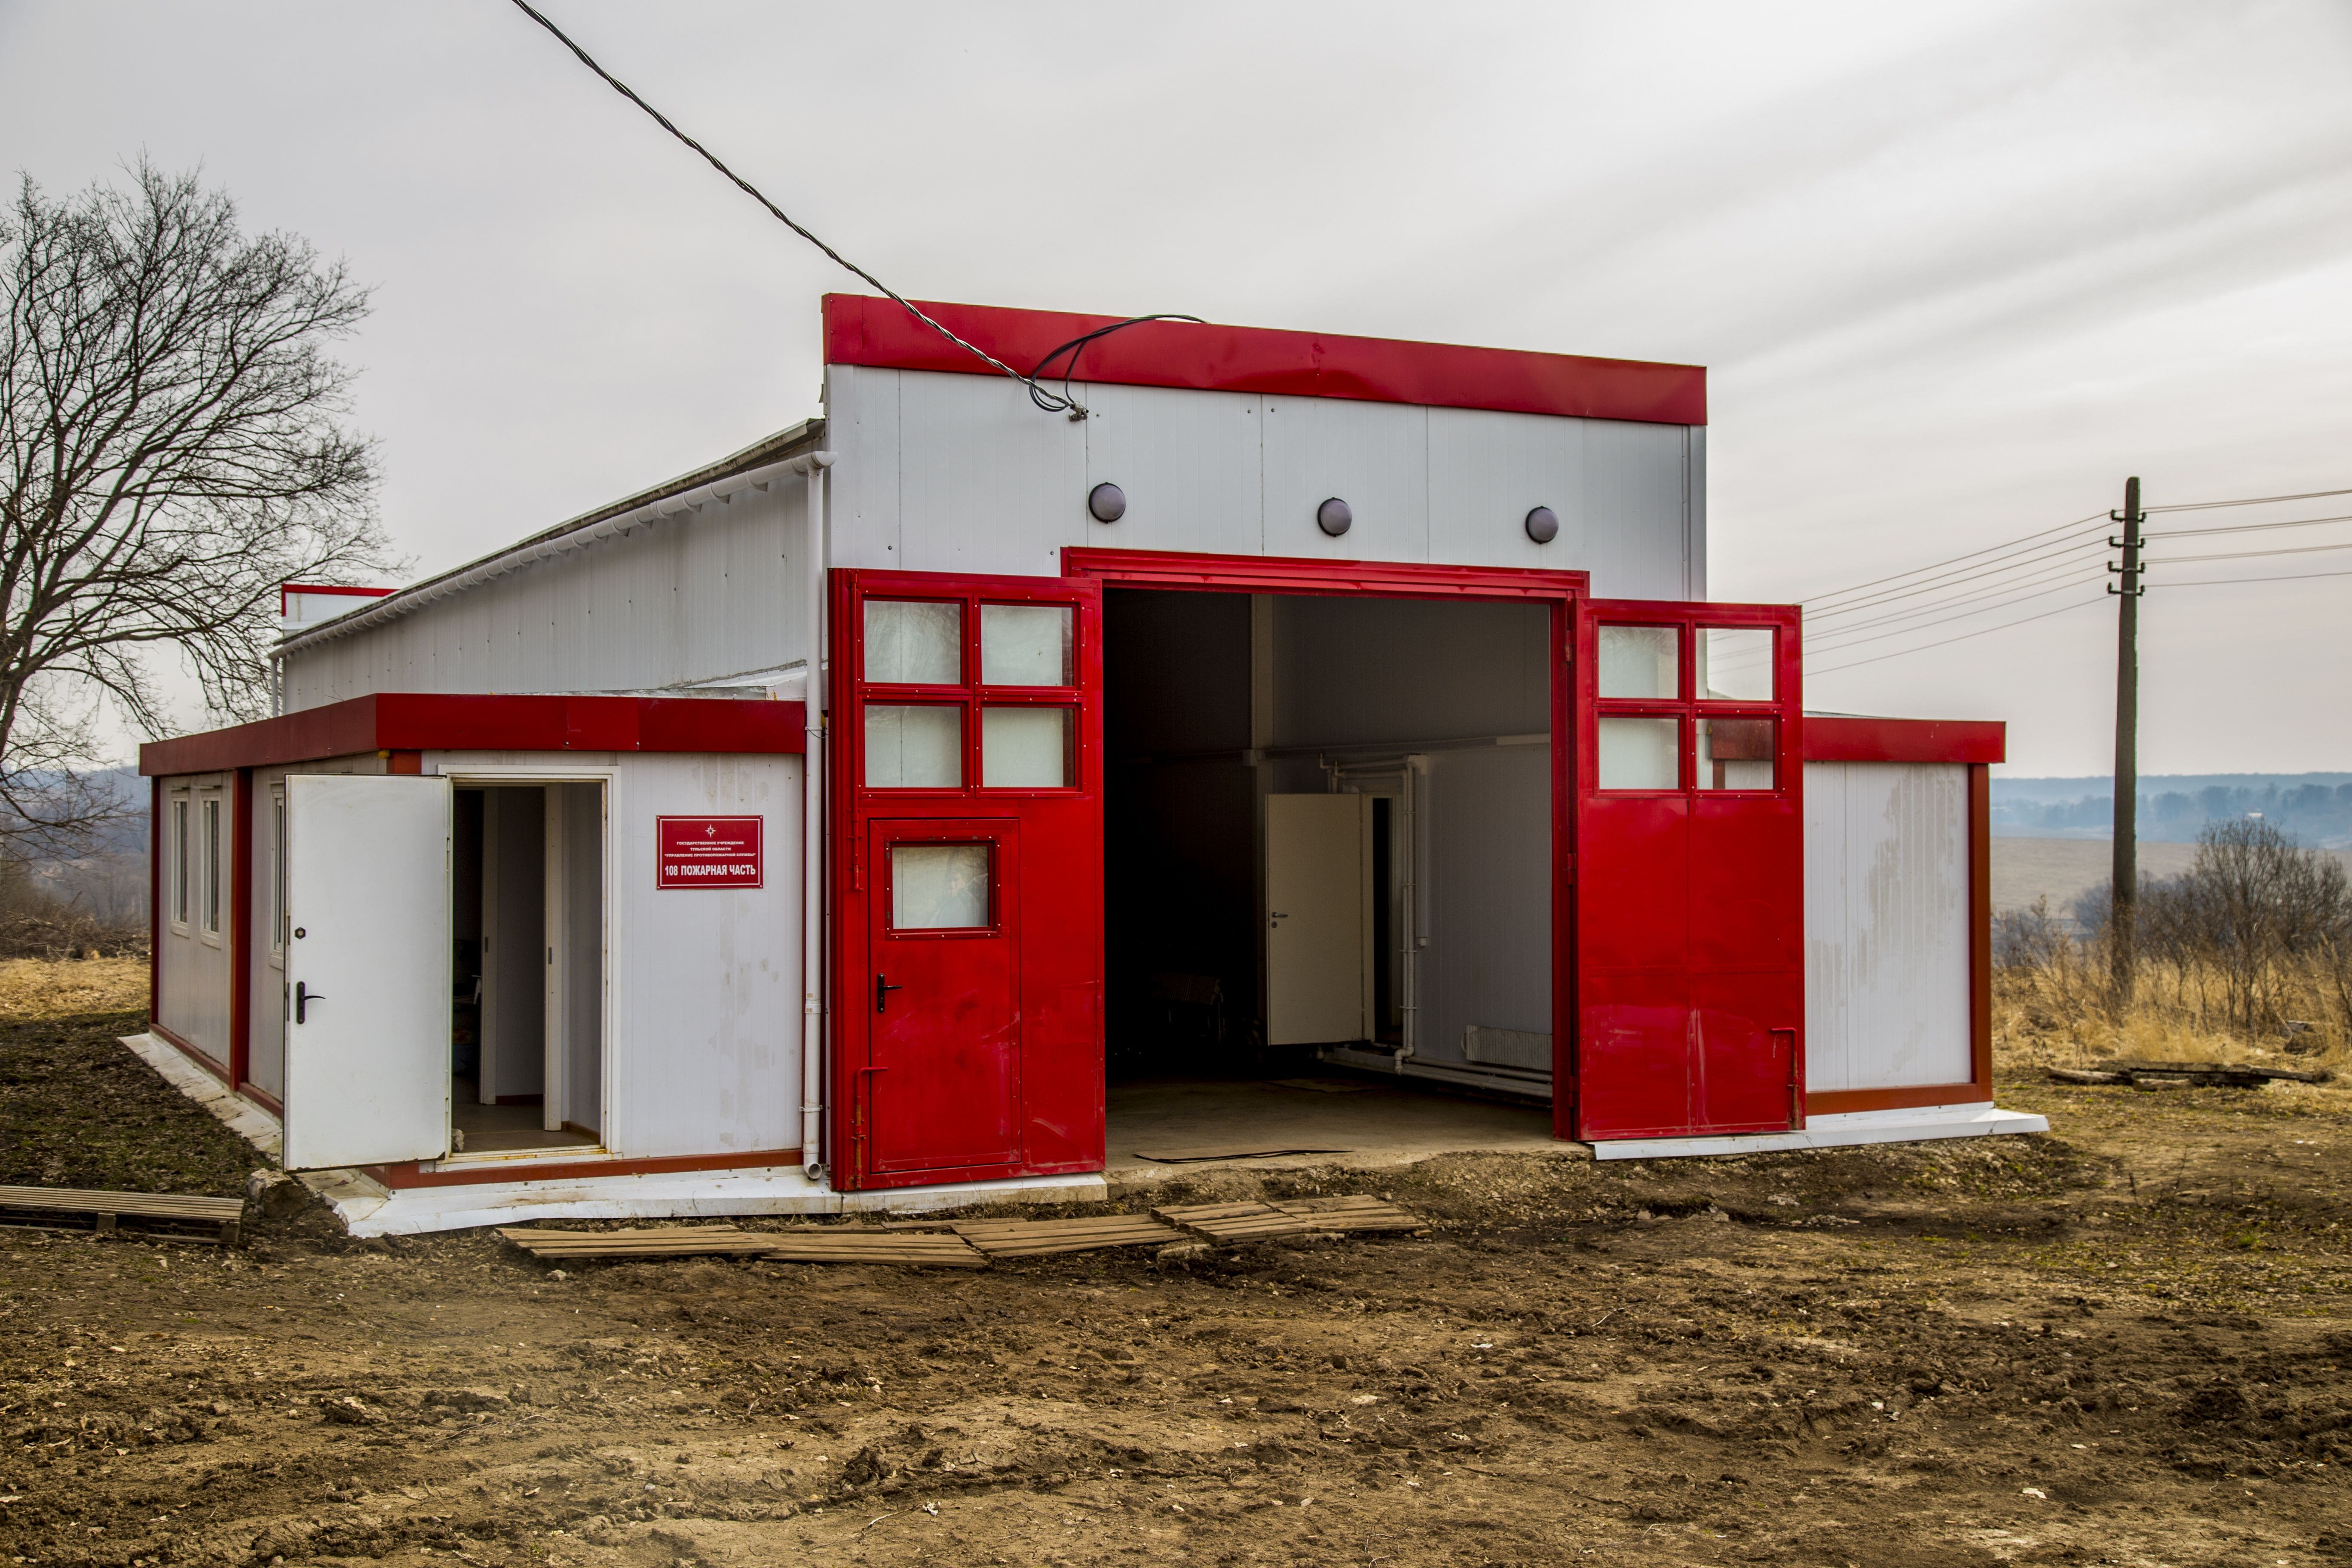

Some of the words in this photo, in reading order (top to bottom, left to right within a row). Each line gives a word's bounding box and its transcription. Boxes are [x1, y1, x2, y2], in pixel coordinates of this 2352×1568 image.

[665, 865, 678, 876] 108
[681, 865, 727, 876] ПОЖАРНАЯ
[729, 864, 756, 875] ЧАСТЬ
